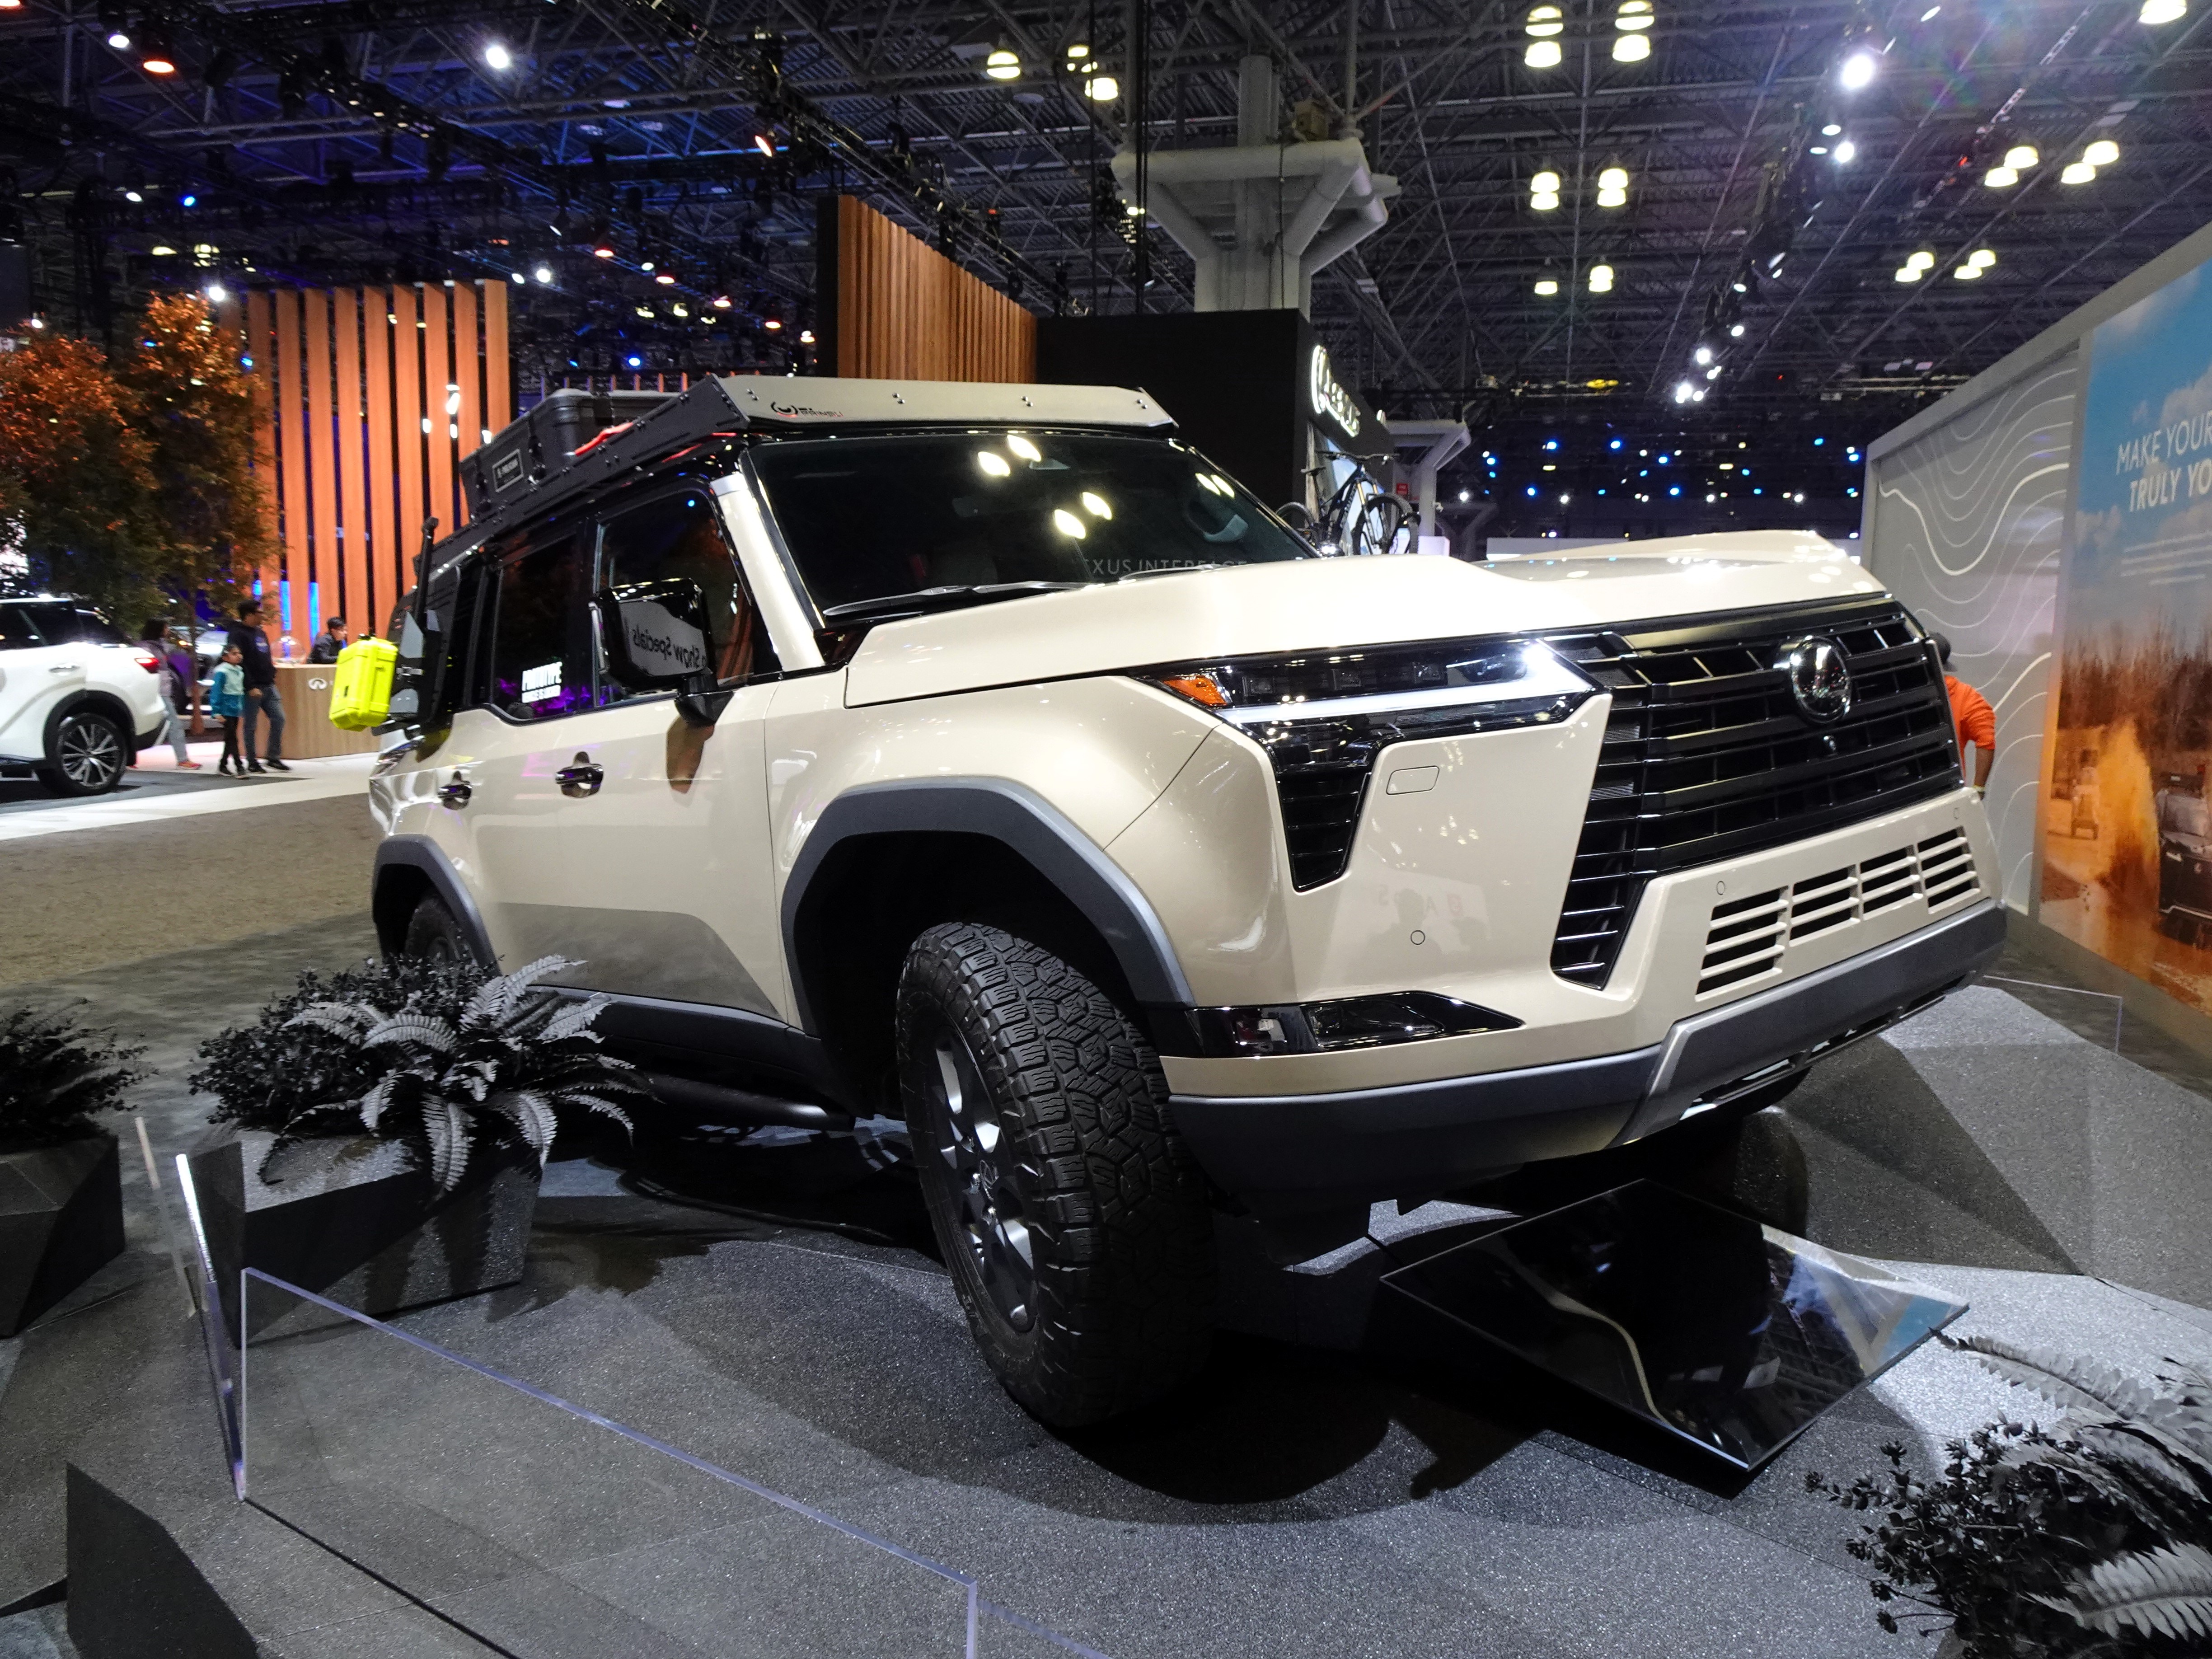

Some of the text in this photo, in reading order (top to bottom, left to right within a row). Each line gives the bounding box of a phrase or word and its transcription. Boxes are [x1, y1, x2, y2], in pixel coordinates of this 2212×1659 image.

[2116, 410, 2212, 475] MAKE YOUR
[2129, 467, 2182, 513] TRULY
[1073, 559, 1131, 575] XUS
